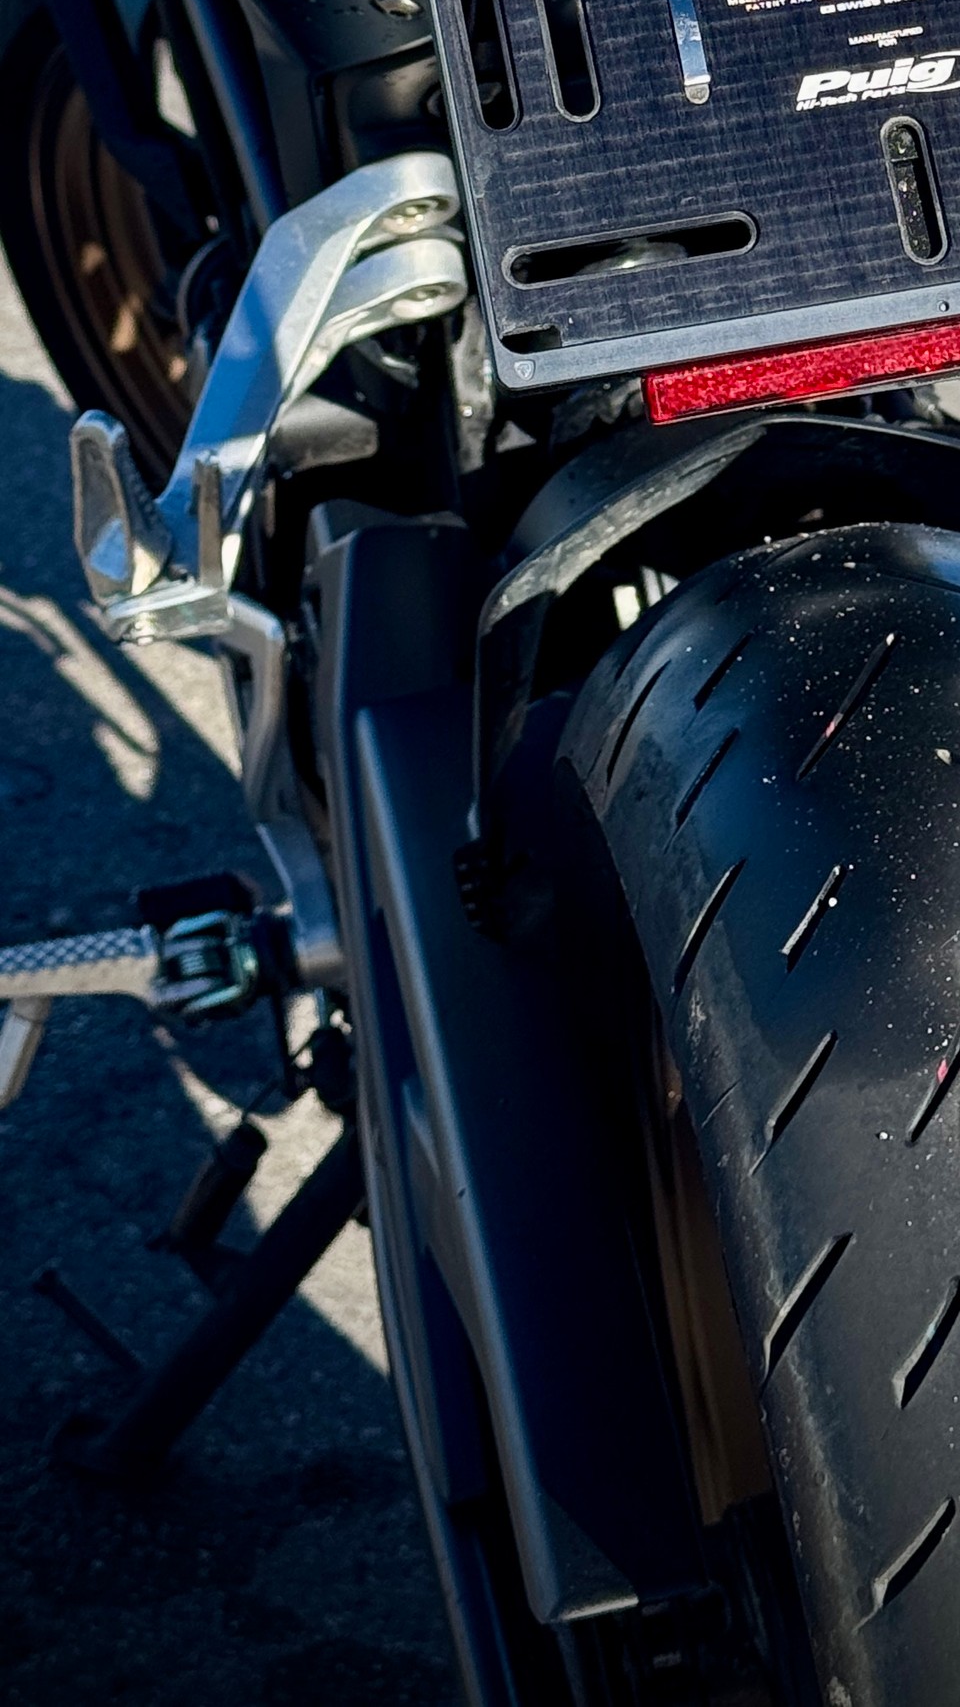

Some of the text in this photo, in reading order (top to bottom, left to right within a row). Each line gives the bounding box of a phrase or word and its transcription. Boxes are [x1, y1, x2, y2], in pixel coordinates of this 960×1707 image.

[848, 26, 924, 46] MANUFACTURED
[877, 38, 898, 49] FOR
[796, 55, 957, 102] Puig
[862, 85, 906, 101] Parts
